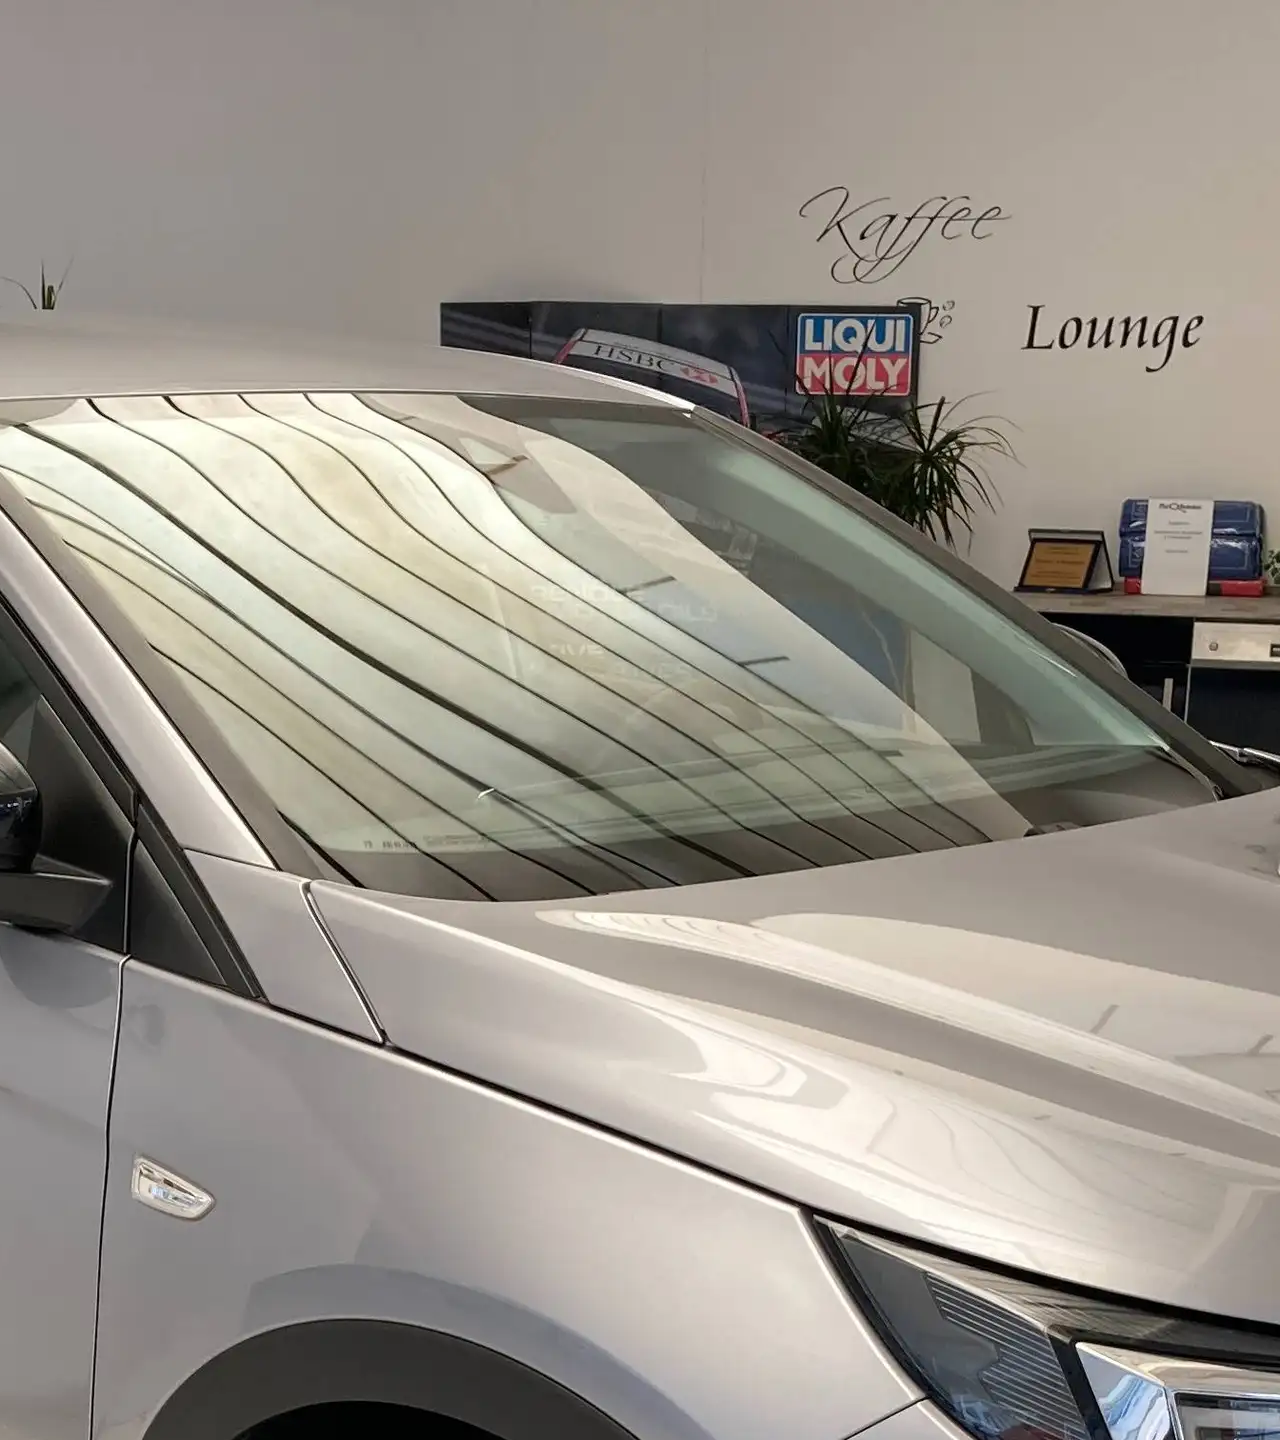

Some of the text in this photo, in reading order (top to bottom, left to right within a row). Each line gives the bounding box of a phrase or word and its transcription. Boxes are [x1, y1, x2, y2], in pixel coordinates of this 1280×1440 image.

[799, 186, 1012, 284] Kaffee
[804, 318, 906, 354] LIQUI
[1021, 304, 1204, 373] Lounge
[593, 344, 676, 371] HSBC
[803, 357, 908, 391] MOLY
